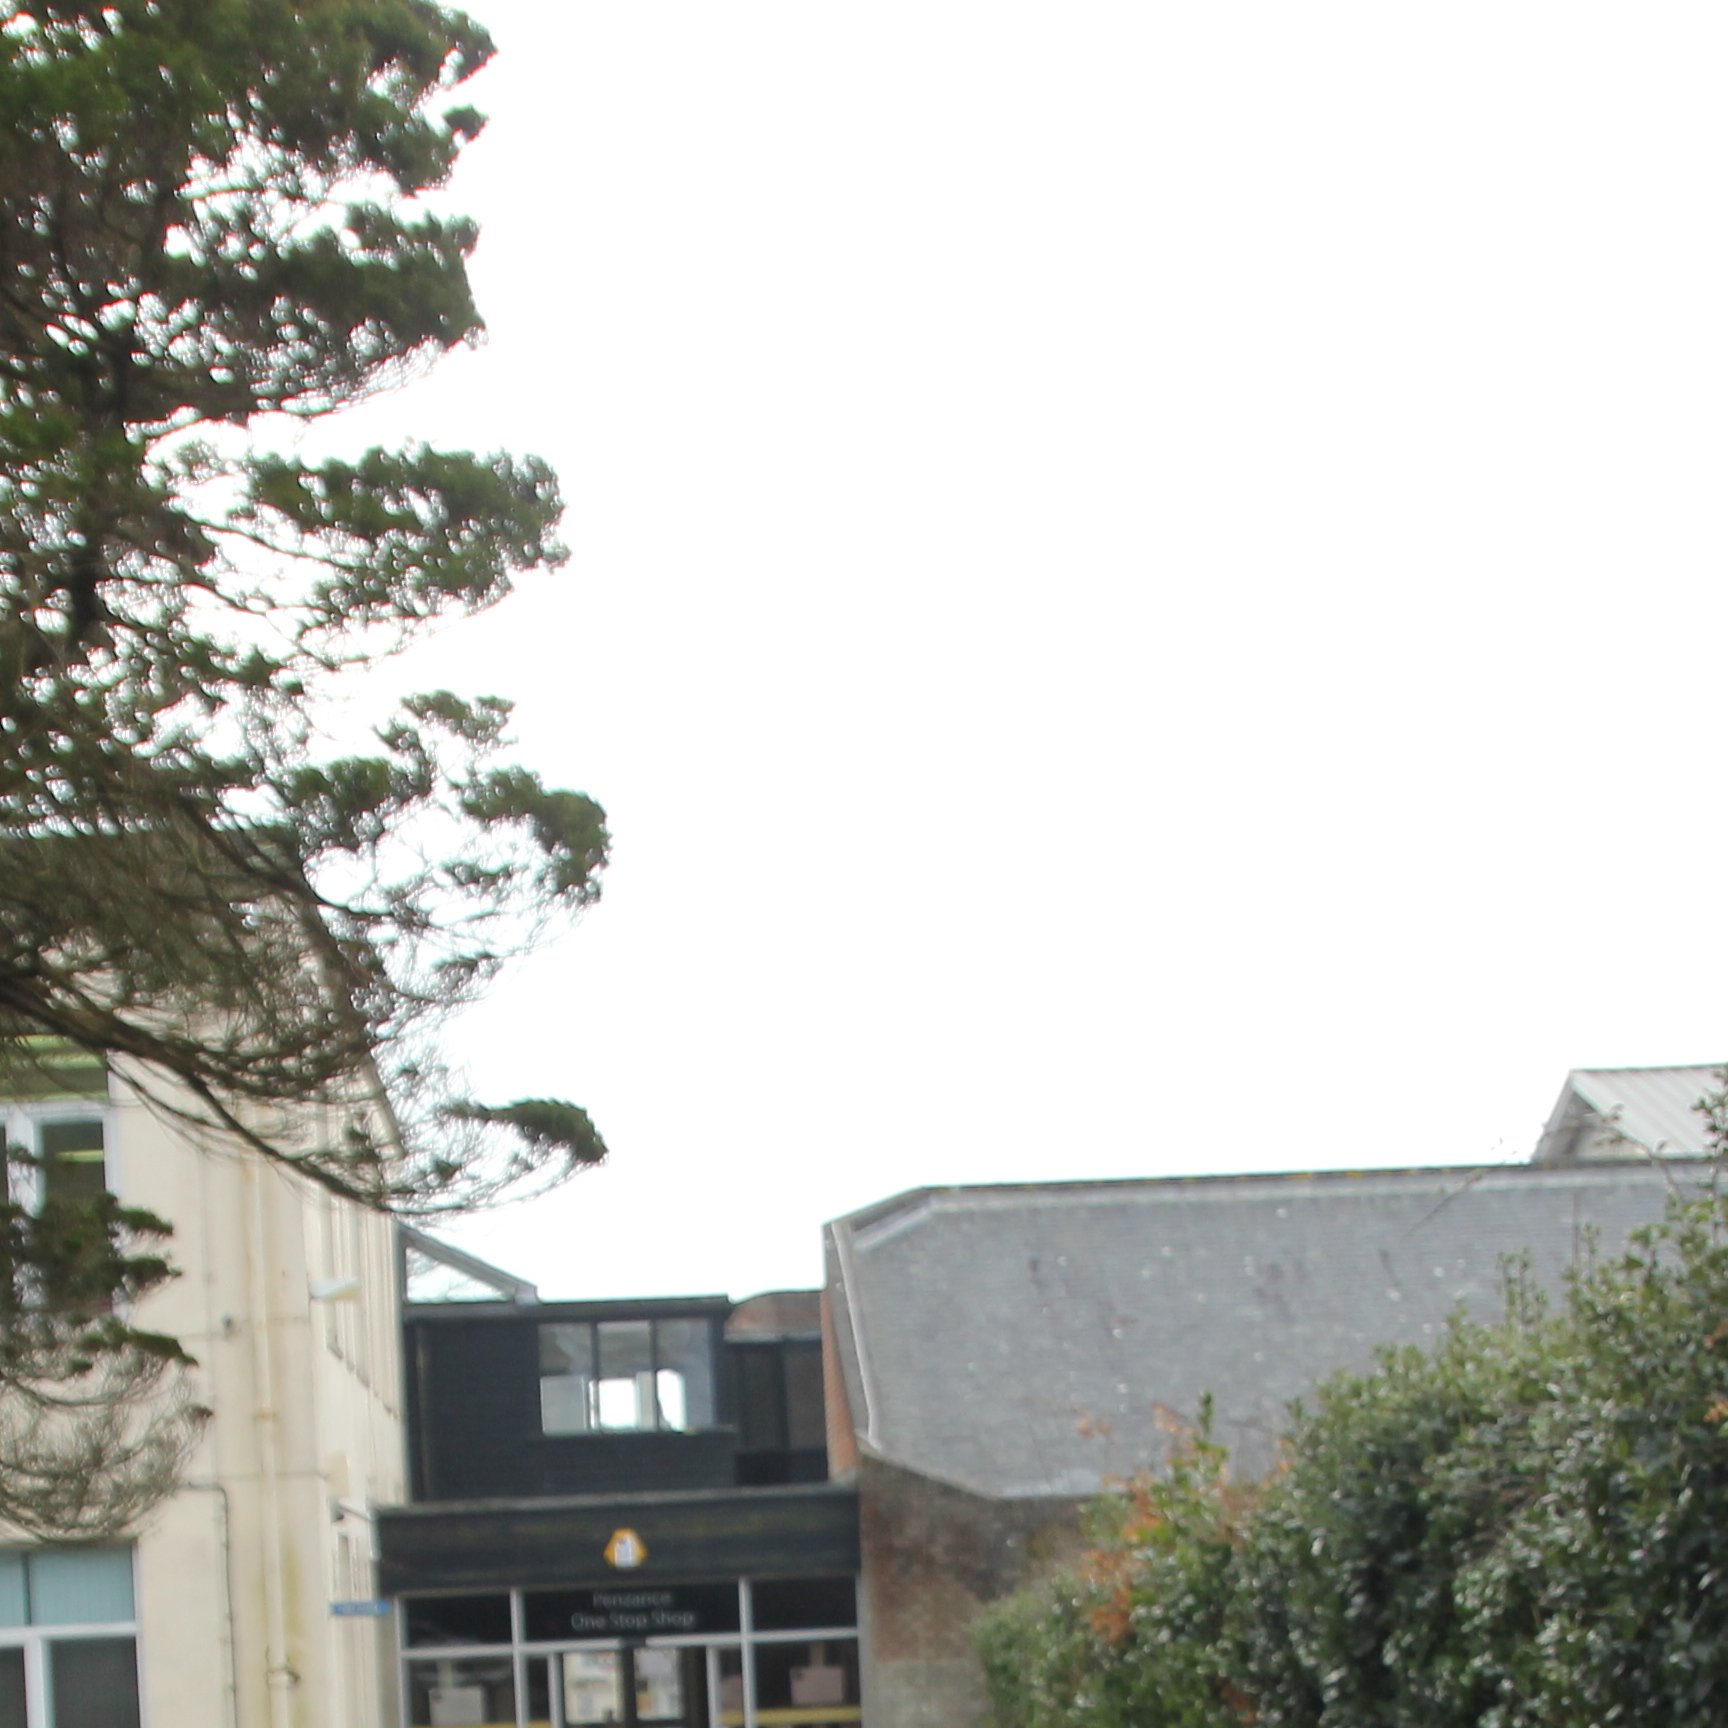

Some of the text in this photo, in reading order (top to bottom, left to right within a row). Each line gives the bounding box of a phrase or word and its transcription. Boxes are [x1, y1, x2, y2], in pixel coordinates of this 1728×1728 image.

[592, 1591, 673, 1609] Penzance
[571, 1608, 696, 1631] One Stop Shop
